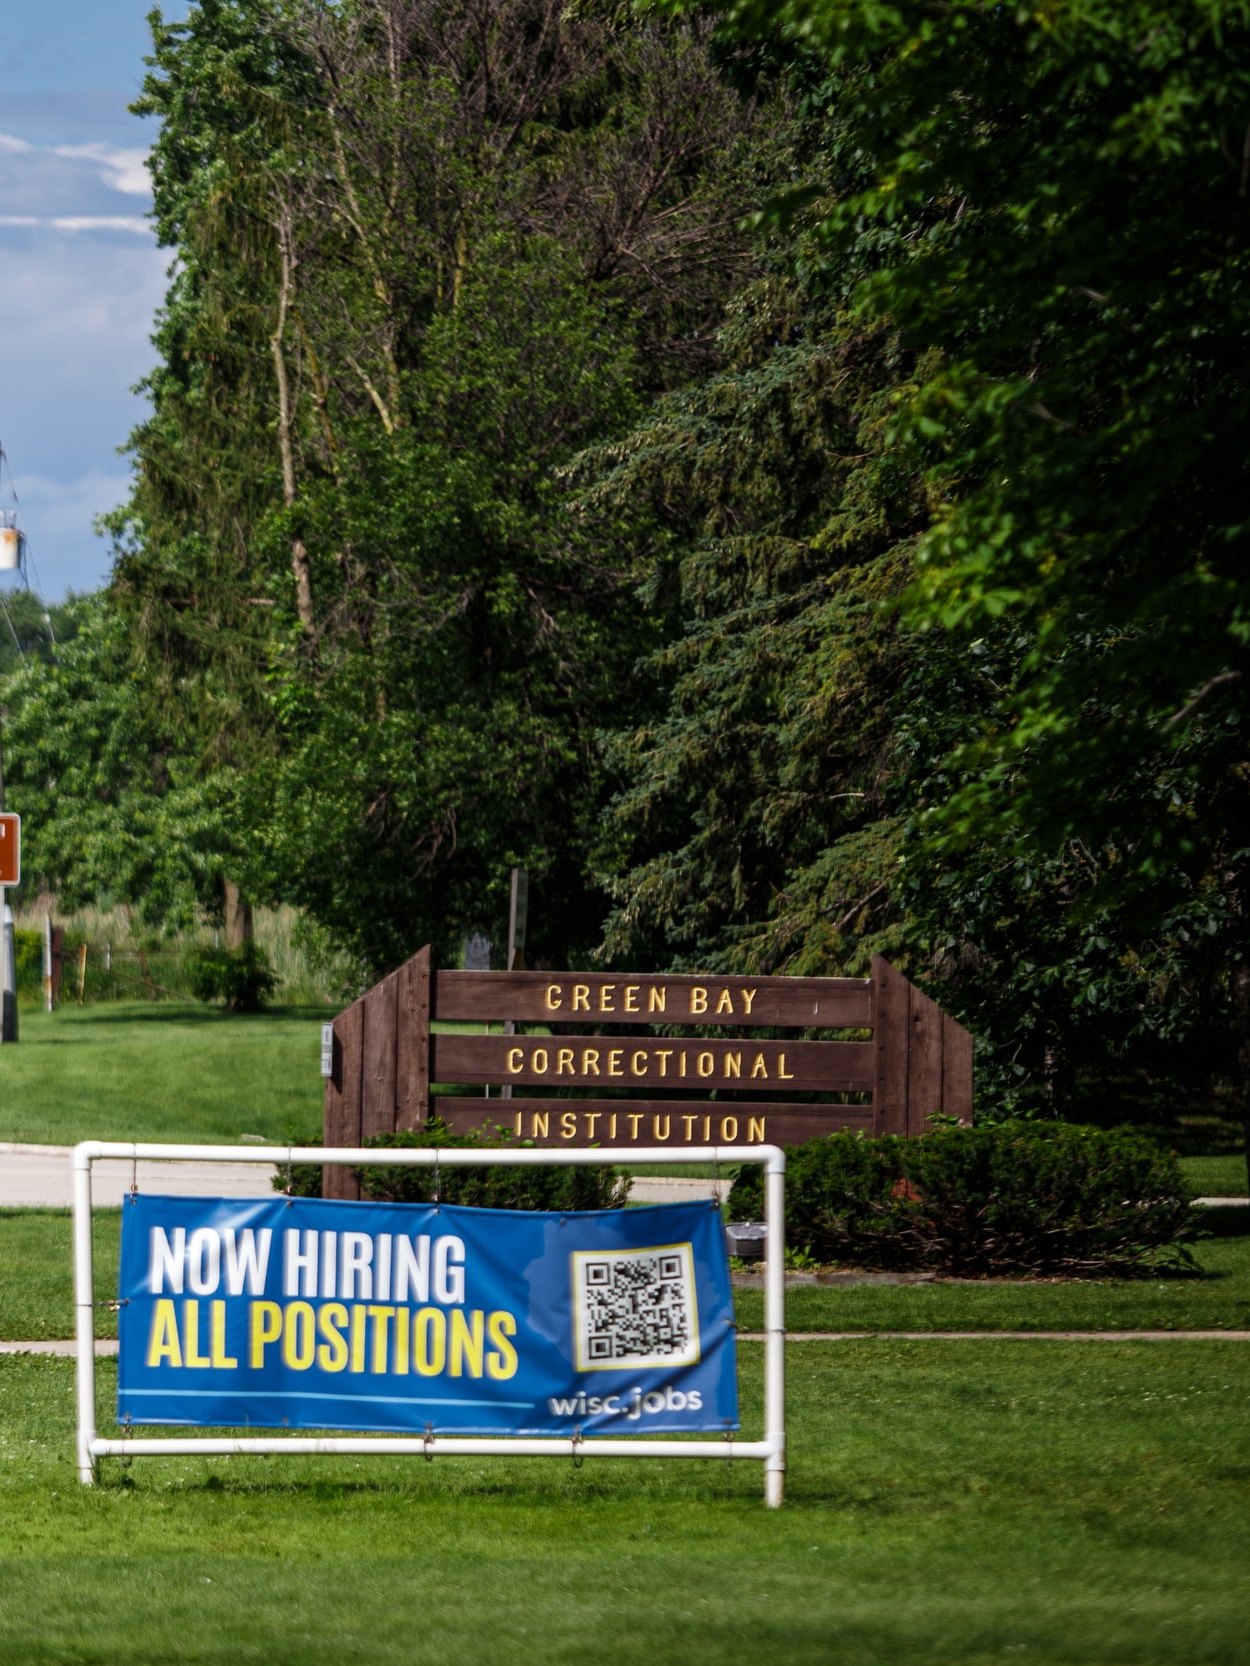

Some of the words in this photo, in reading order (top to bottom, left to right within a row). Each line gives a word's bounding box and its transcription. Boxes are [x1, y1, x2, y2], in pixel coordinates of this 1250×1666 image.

[546, 984, 667, 1012] GREEN
[691, 986, 757, 1014] BAY
[507, 1047, 795, 1079] CORRECTIONAL
[515, 1111, 767, 1143] INSTITUTION
[150, 1226, 273, 1296] NOW
[285, 1228, 466, 1304] HIRING
[147, 1299, 238, 1368] ALL
[250, 1300, 519, 1380] POSITIONS
[550, 1386, 704, 1420] wisc.jobs
